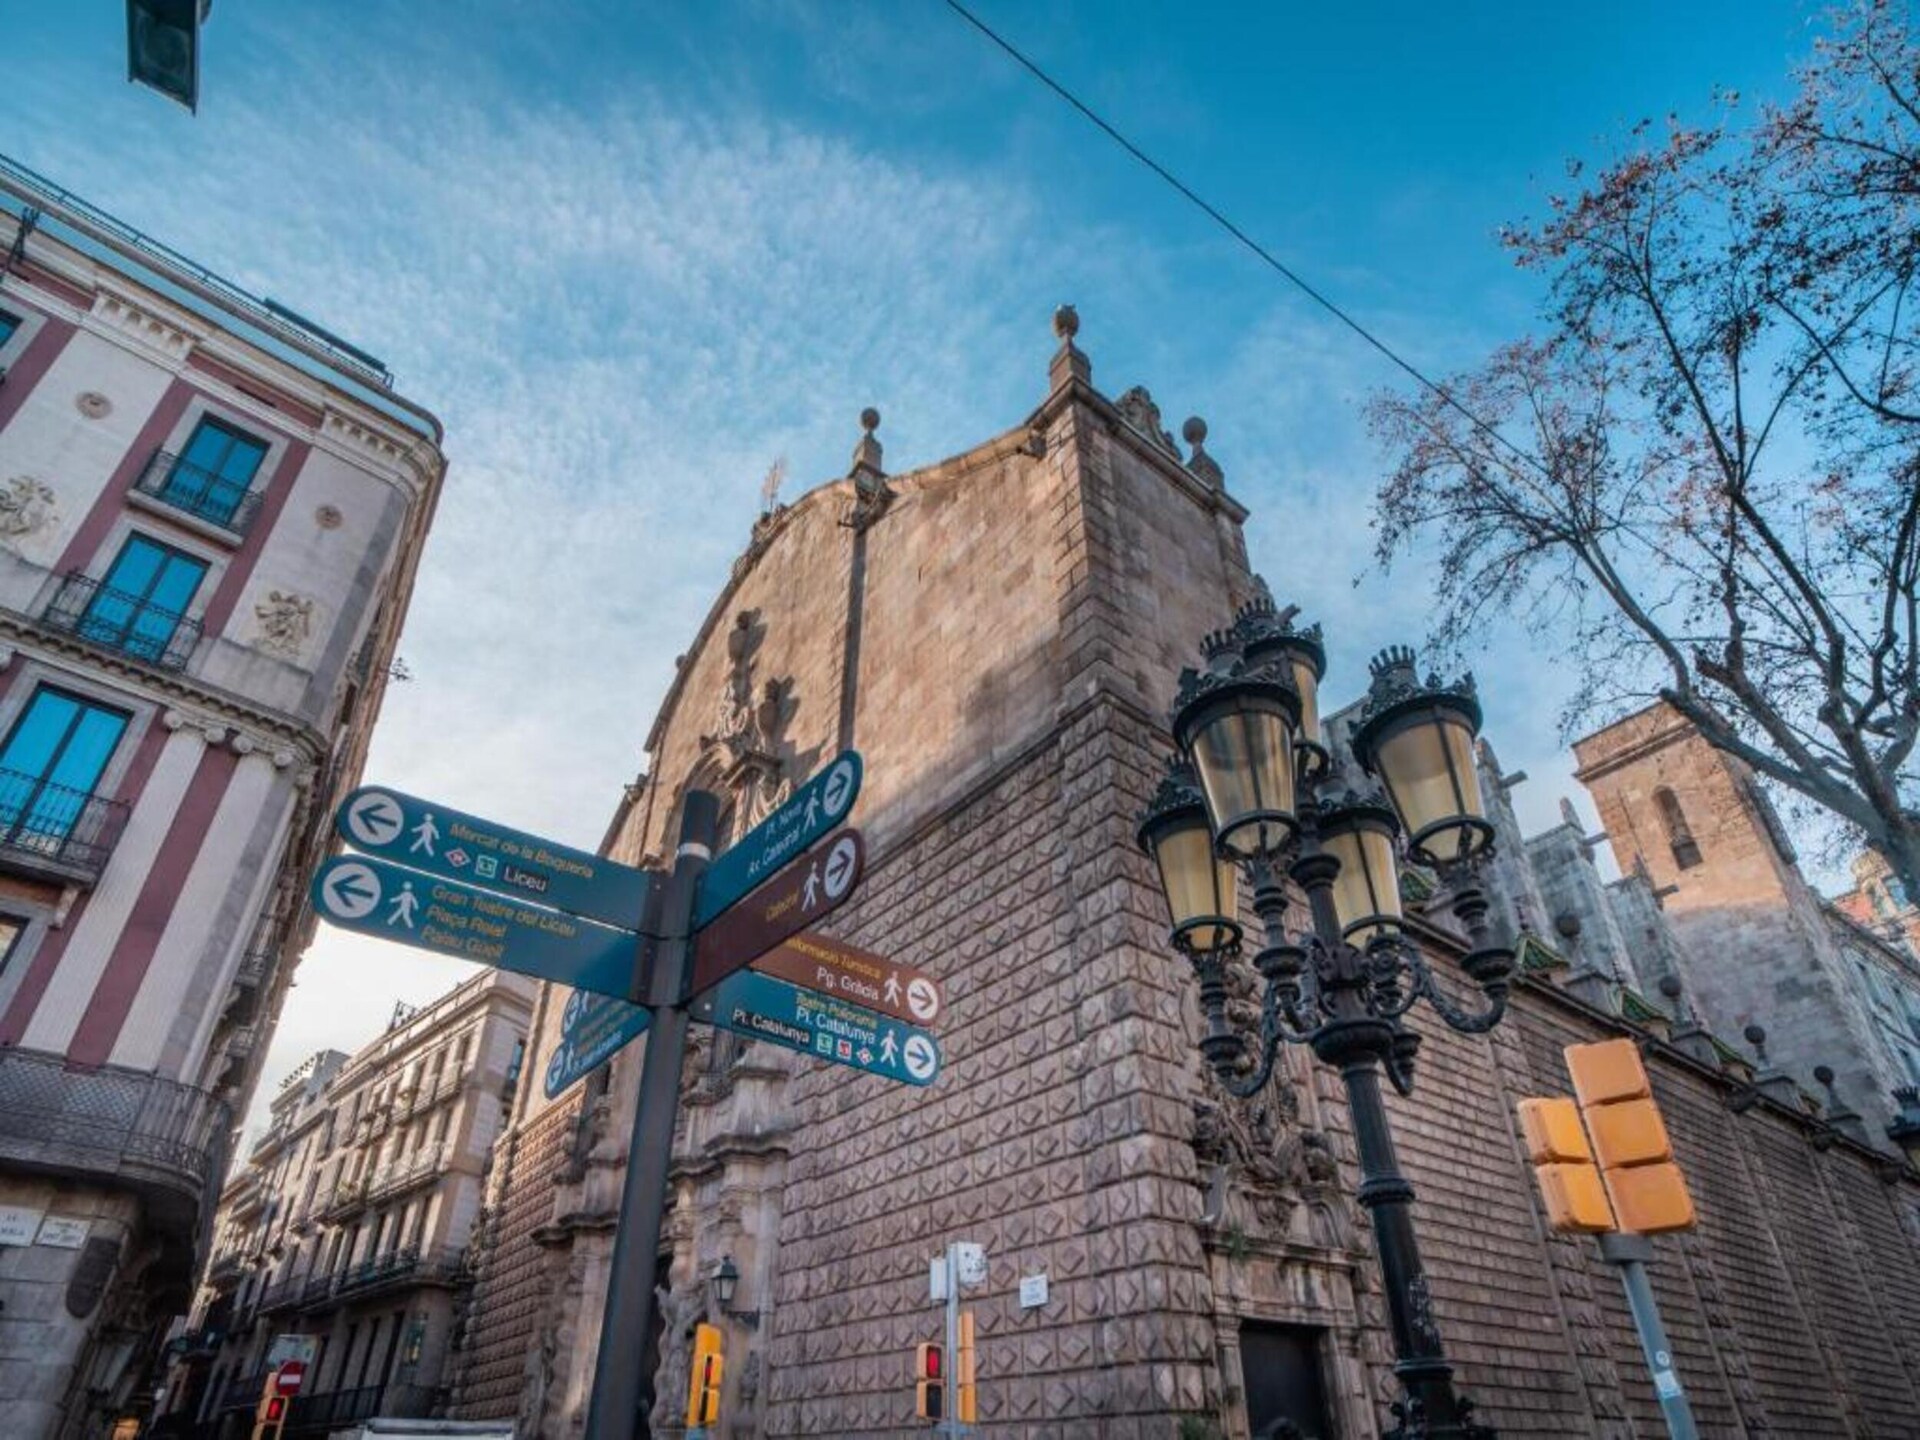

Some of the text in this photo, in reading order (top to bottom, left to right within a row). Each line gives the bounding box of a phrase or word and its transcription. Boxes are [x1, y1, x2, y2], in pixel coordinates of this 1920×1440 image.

[450, 822, 593, 878] Mercat de la Boqueria
[504, 865, 547, 892] Liceu
[432, 884, 576, 938] Gran Teatre del Liceu
[817, 966, 837, 989] Pg.
[733, 1008, 749, 1025] Pl.
[752, 1014, 810, 1044] Catalunya
[796, 1006, 813, 1025] Pl.
[816, 1013, 876, 1045] Catalunya
